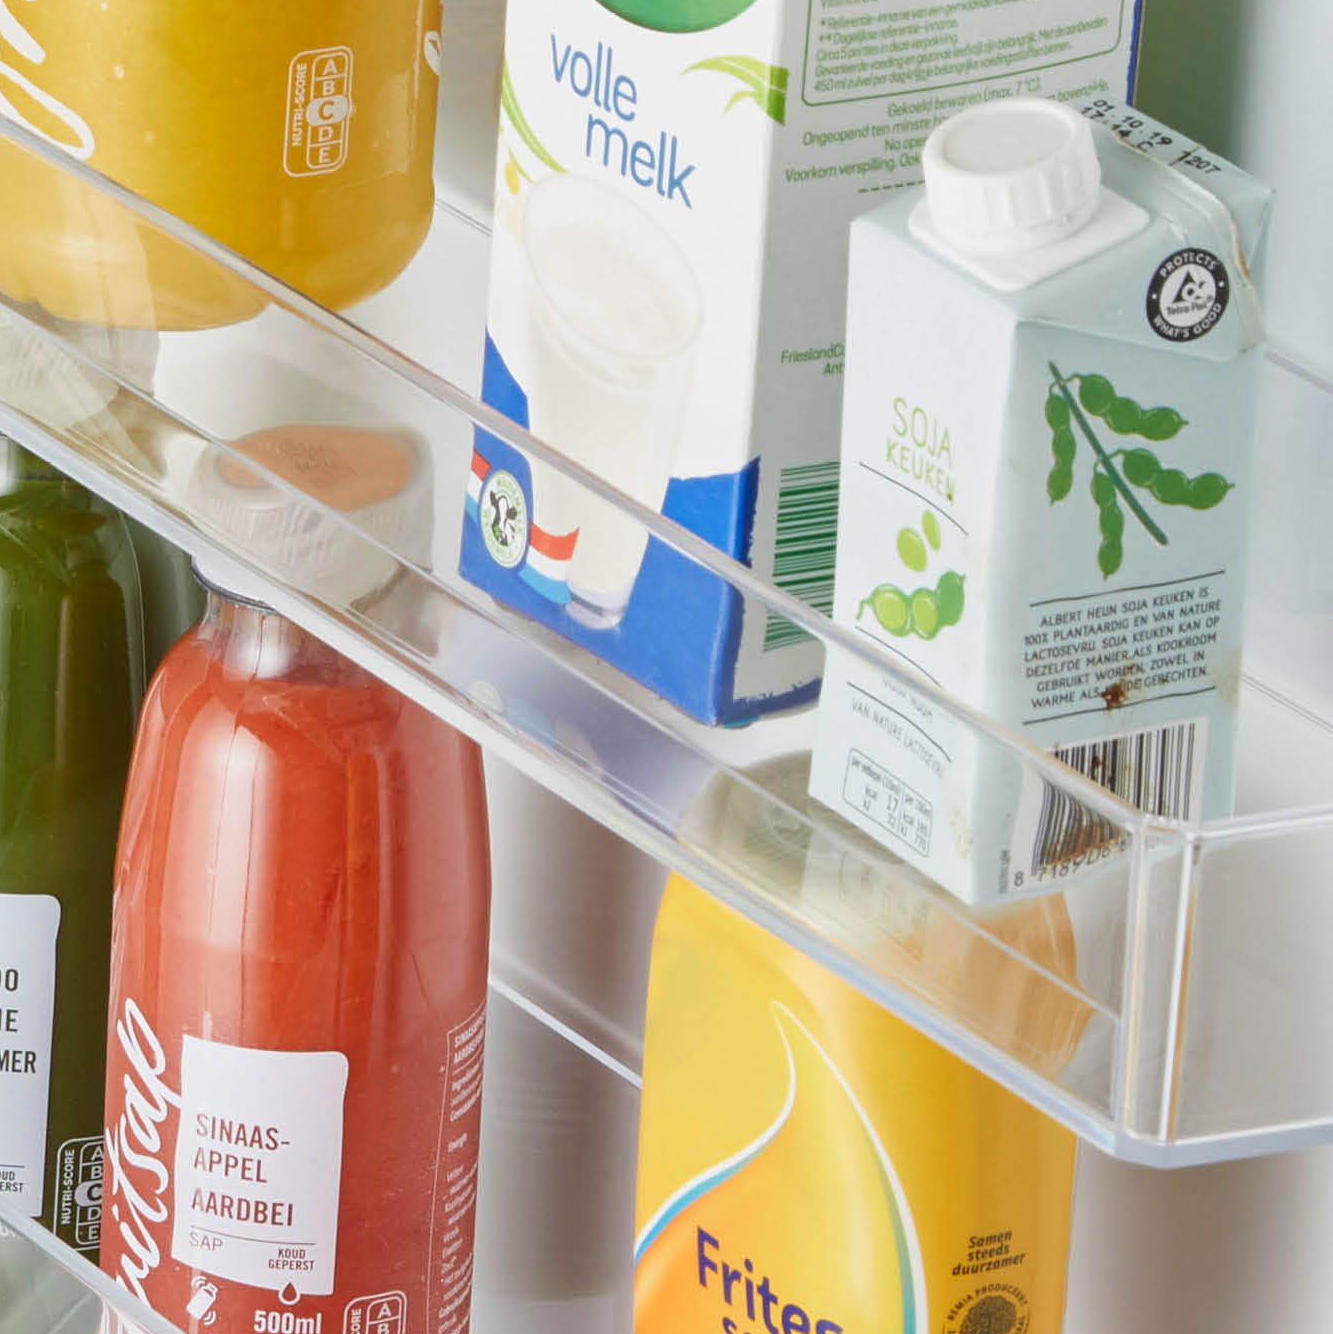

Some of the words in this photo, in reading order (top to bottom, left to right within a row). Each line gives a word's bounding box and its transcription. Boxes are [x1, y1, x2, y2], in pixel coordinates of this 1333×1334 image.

[323, 57, 340, 75] A
[323, 80, 336, 96] B
[549, 33, 639, 122] volle
[291, 62, 308, 147] NUTRI-SCORE
[316, 99, 336, 121] C
[318, 124, 335, 142] D
[317, 147, 332, 165] E
[585, 114, 696, 209] melk
[1160, 251, 1219, 278] PROTECTS
[1153, 314, 1190, 339] WHAT'S
[1193, 302, 1223, 335] GOOD
[892, 396, 953, 471] SOJA
[885, 437, 955, 505] KEUKEN
[1040, 610, 1082, 628] ALBERT
[1122, 599, 1148, 613] SOJA
[1153, 589, 1194, 608] KEUKEN
[1199, 586, 1209, 598] IS
[1053, 618, 1130, 642] PLANTAARDIG
[1133, 614, 1149, 627] EN
[1153, 610, 1175, 624] VAN
[1180, 599, 1222, 617] NATURE
[1102, 634, 1128, 649] SOJA
[1133, 624, 1174, 642] KEUKEN
[1179, 619, 1201, 633] KAN
[1206, 615, 1221, 628] OP
[1025, 659, 1081, 679] DEZELFDE
[1086, 650, 1128, 668] MANIER
[1133, 644, 1153, 658] ALS
[1157, 632, 1218, 653] KOOKROOM
[1036, 673, 1091, 693] GEBRUIKT
[1150, 653, 1190, 671] ZOWEL
[1193, 650, 1206, 662] IN
[852, 698, 871, 718] VAN
[1031, 691, 1076, 709] WARME
[1080, 686, 1100, 701] ALS
[1014, 870, 1024, 887] 8
[196, 1113, 291, 1151] SINAAS-
[90, 1146, 103, 1161] A
[90, 1166, 102, 1180] B
[193, 1151, 268, 1184] APPEL
[60, 1149, 76, 1225] NUTRI-SCORE
[86, 1183, 102, 1202] C
[87, 1206, 101, 1221] D
[190, 1189, 294, 1227] AARDBEI
[88, 1225, 99, 1240] E
[189, 1231, 223, 1252] SAP
[968, 1229, 1013, 1249] Samen
[277, 1247, 306, 1259] KOUD
[967, 1243, 1010, 1262] steeds
[268, 1259, 314, 1272] GEPERST
[952, 1252, 1027, 1277] duurzamer
[376, 1302, 391, 1318] A
